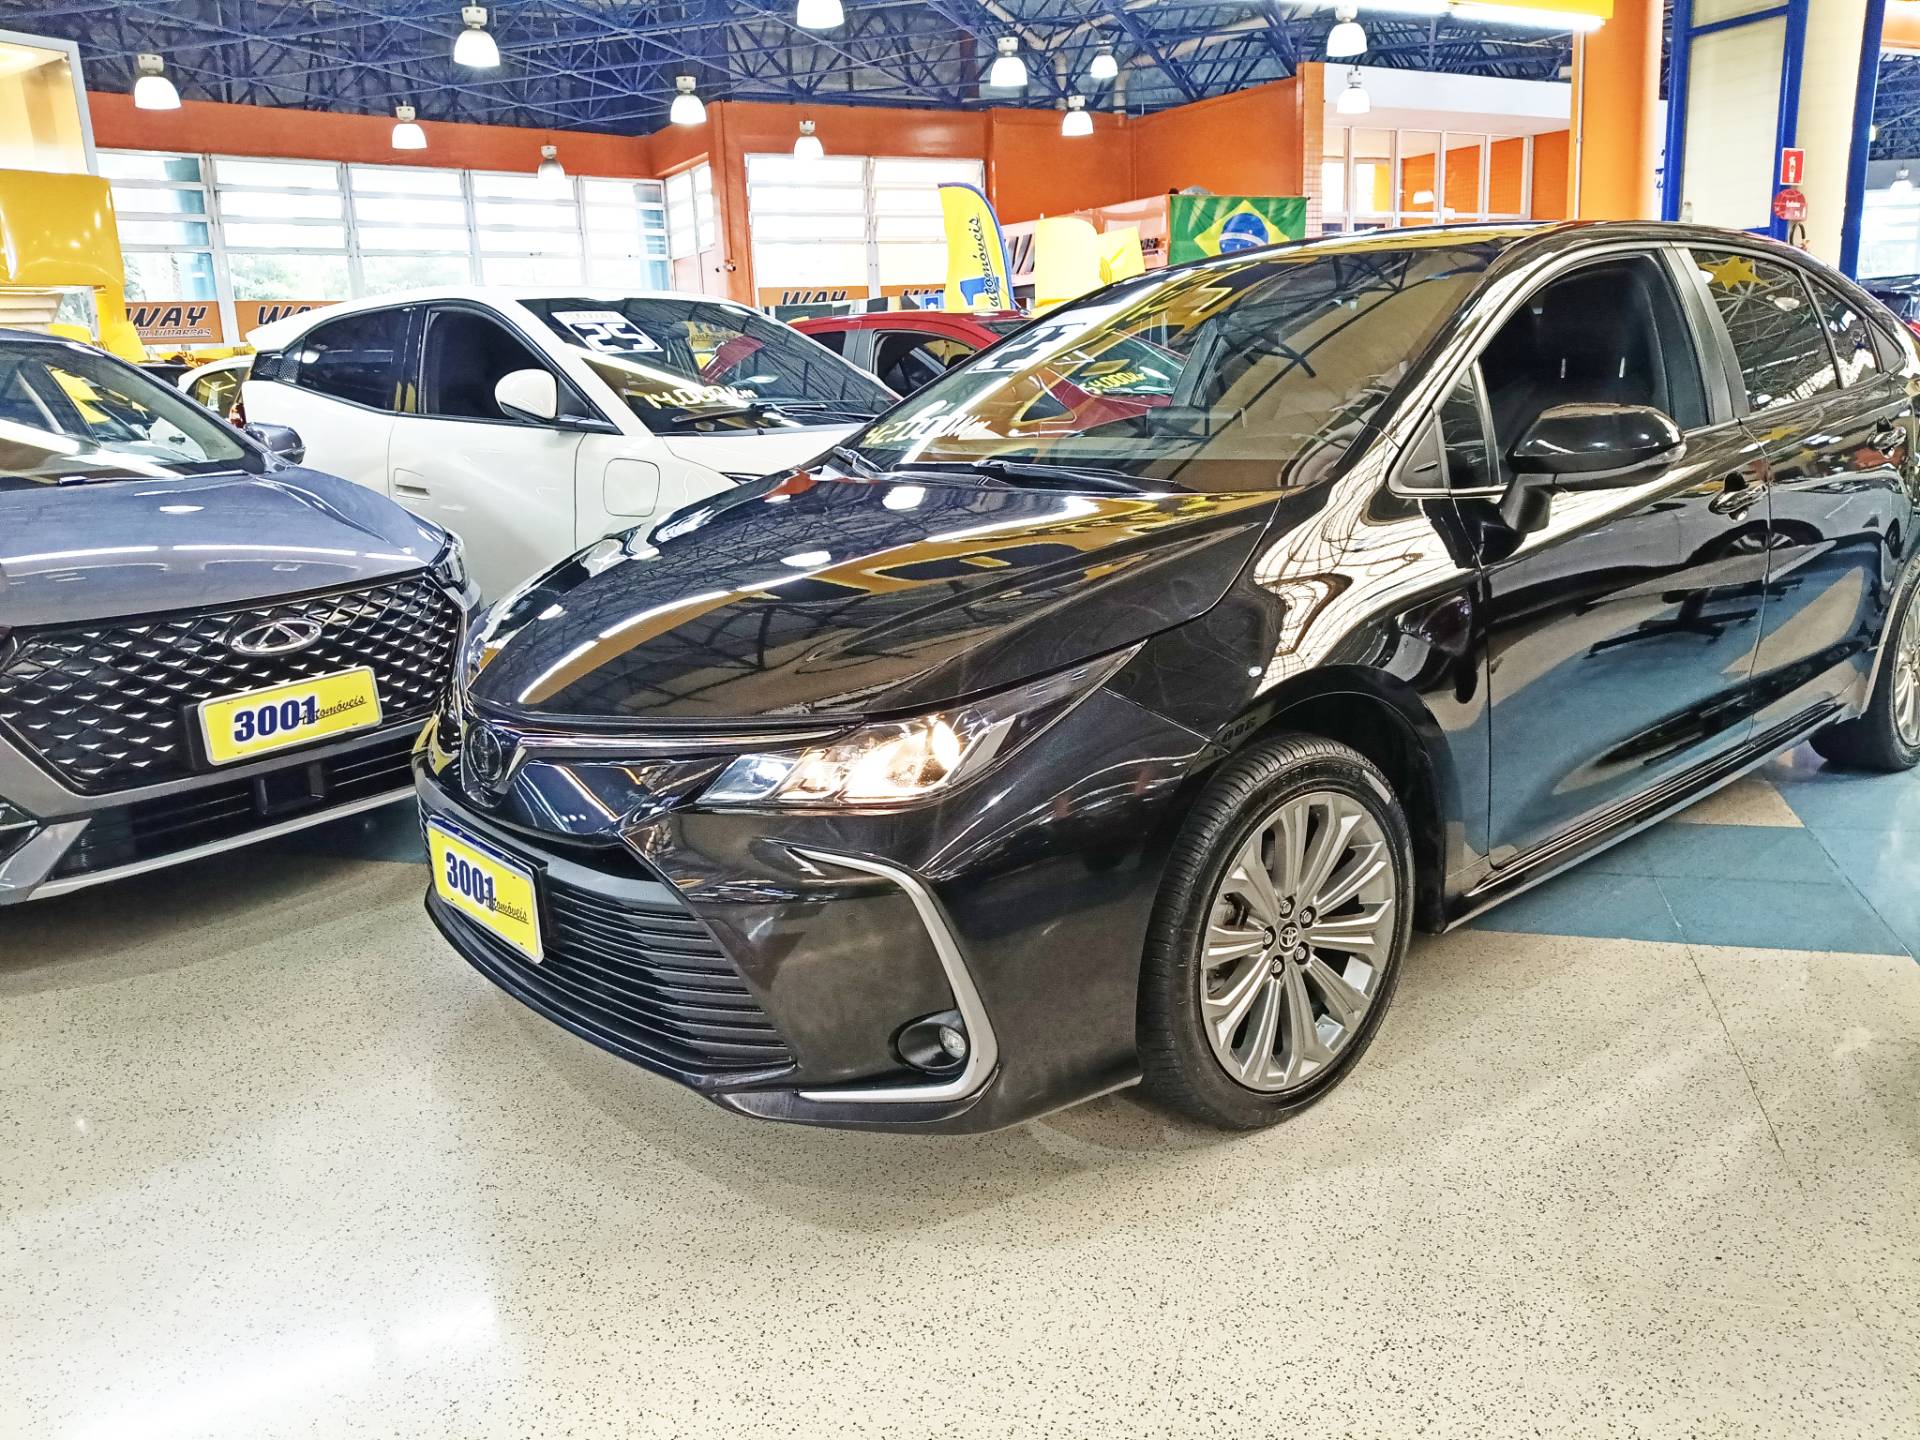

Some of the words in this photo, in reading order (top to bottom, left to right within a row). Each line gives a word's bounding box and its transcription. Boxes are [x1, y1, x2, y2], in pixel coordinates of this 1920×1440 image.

[968, 216, 1000, 308] utomóveis
[125, 306, 208, 328] WAY
[572, 322, 656, 352] 25
[234, 695, 316, 743] 3001
[445, 851, 496, 912] 3001
